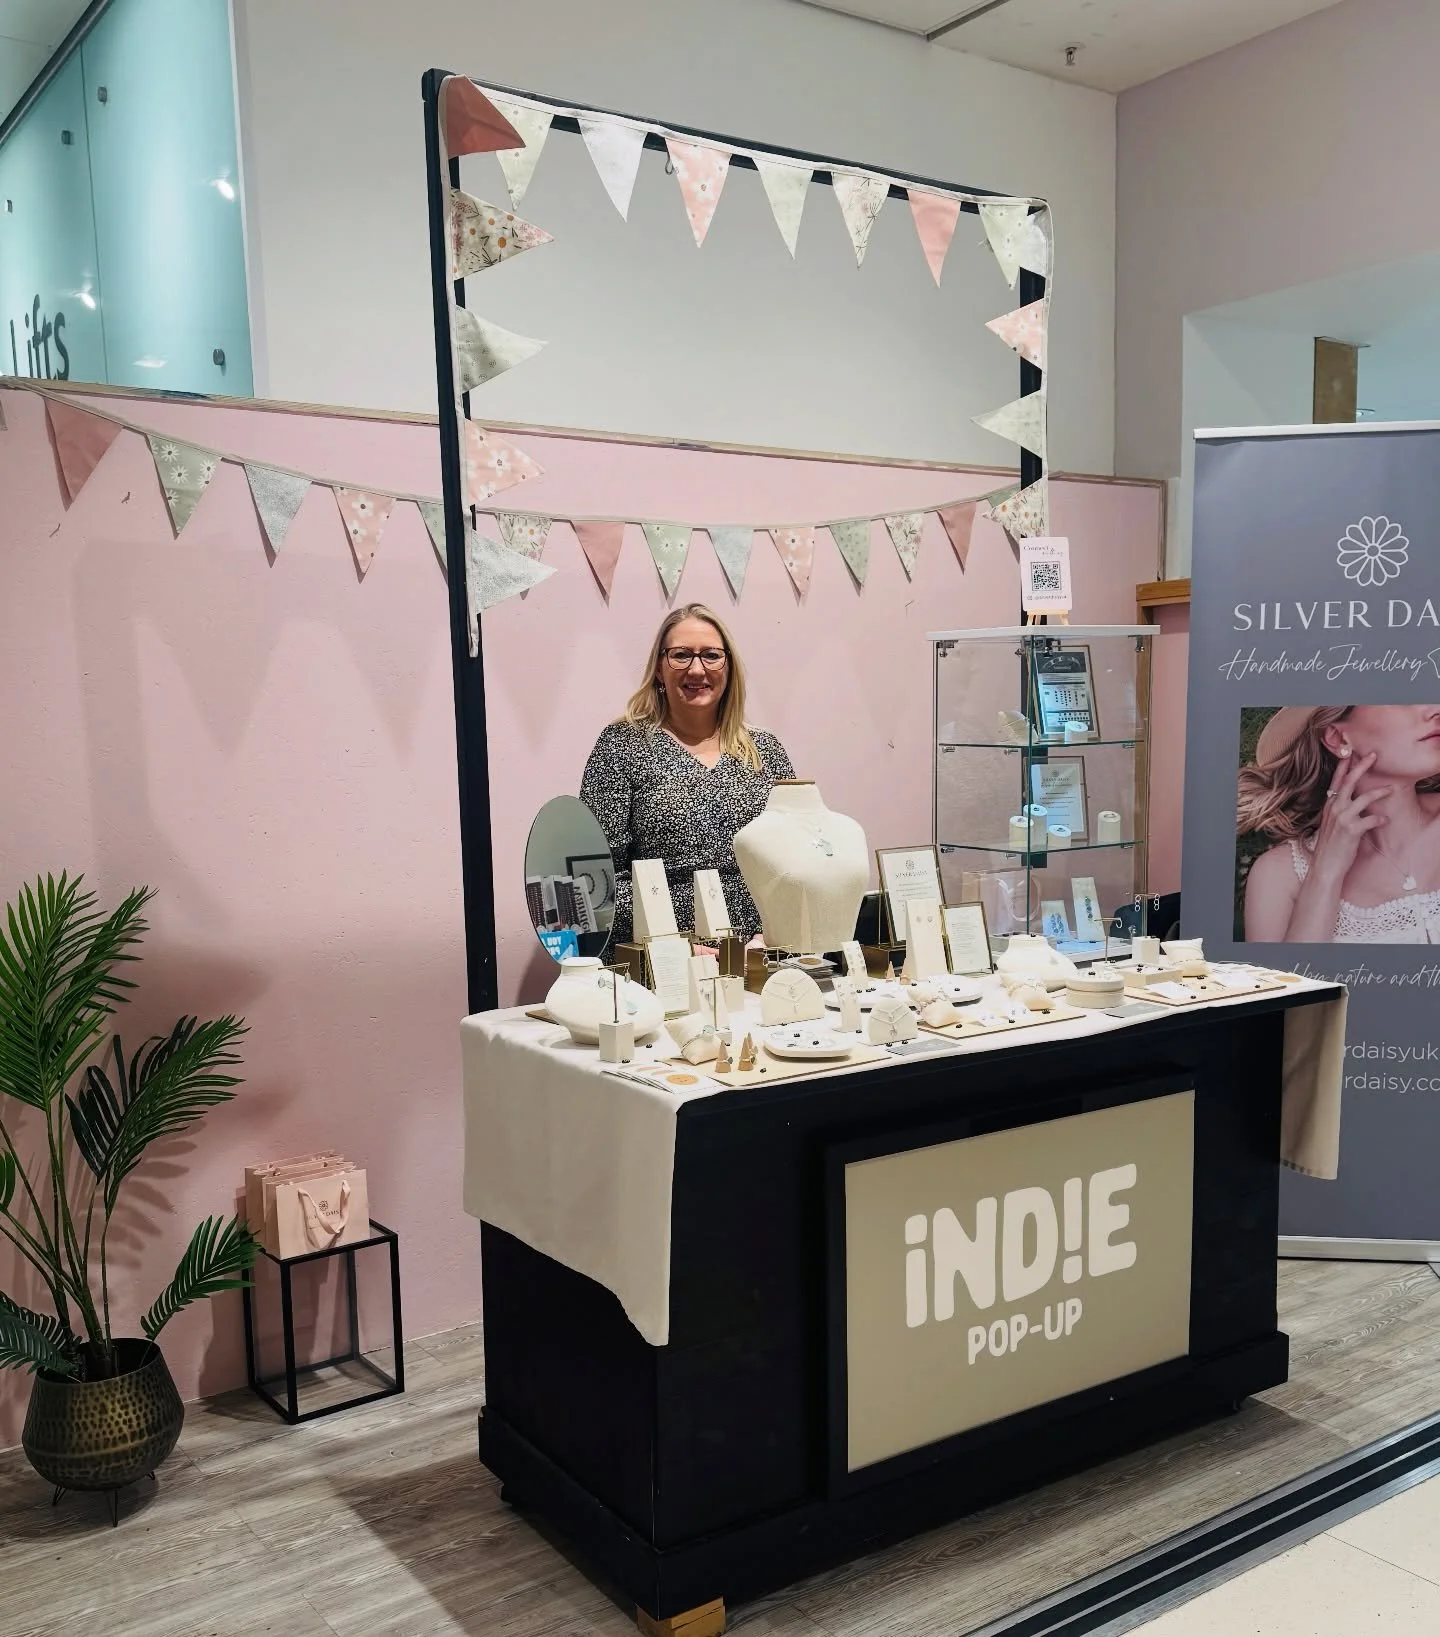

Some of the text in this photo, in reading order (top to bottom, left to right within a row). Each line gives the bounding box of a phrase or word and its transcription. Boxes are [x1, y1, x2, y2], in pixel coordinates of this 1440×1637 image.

[1233, 598, 1440, 631] SILVER DA
[1218, 647, 1327, 681] Handmade
[1327, 643, 1428, 681] Jewellery
[1334, 963, 1386, 987] nature
[1390, 964, 1426, 987] and
[967, 1297, 1083, 1365] POP-UP
